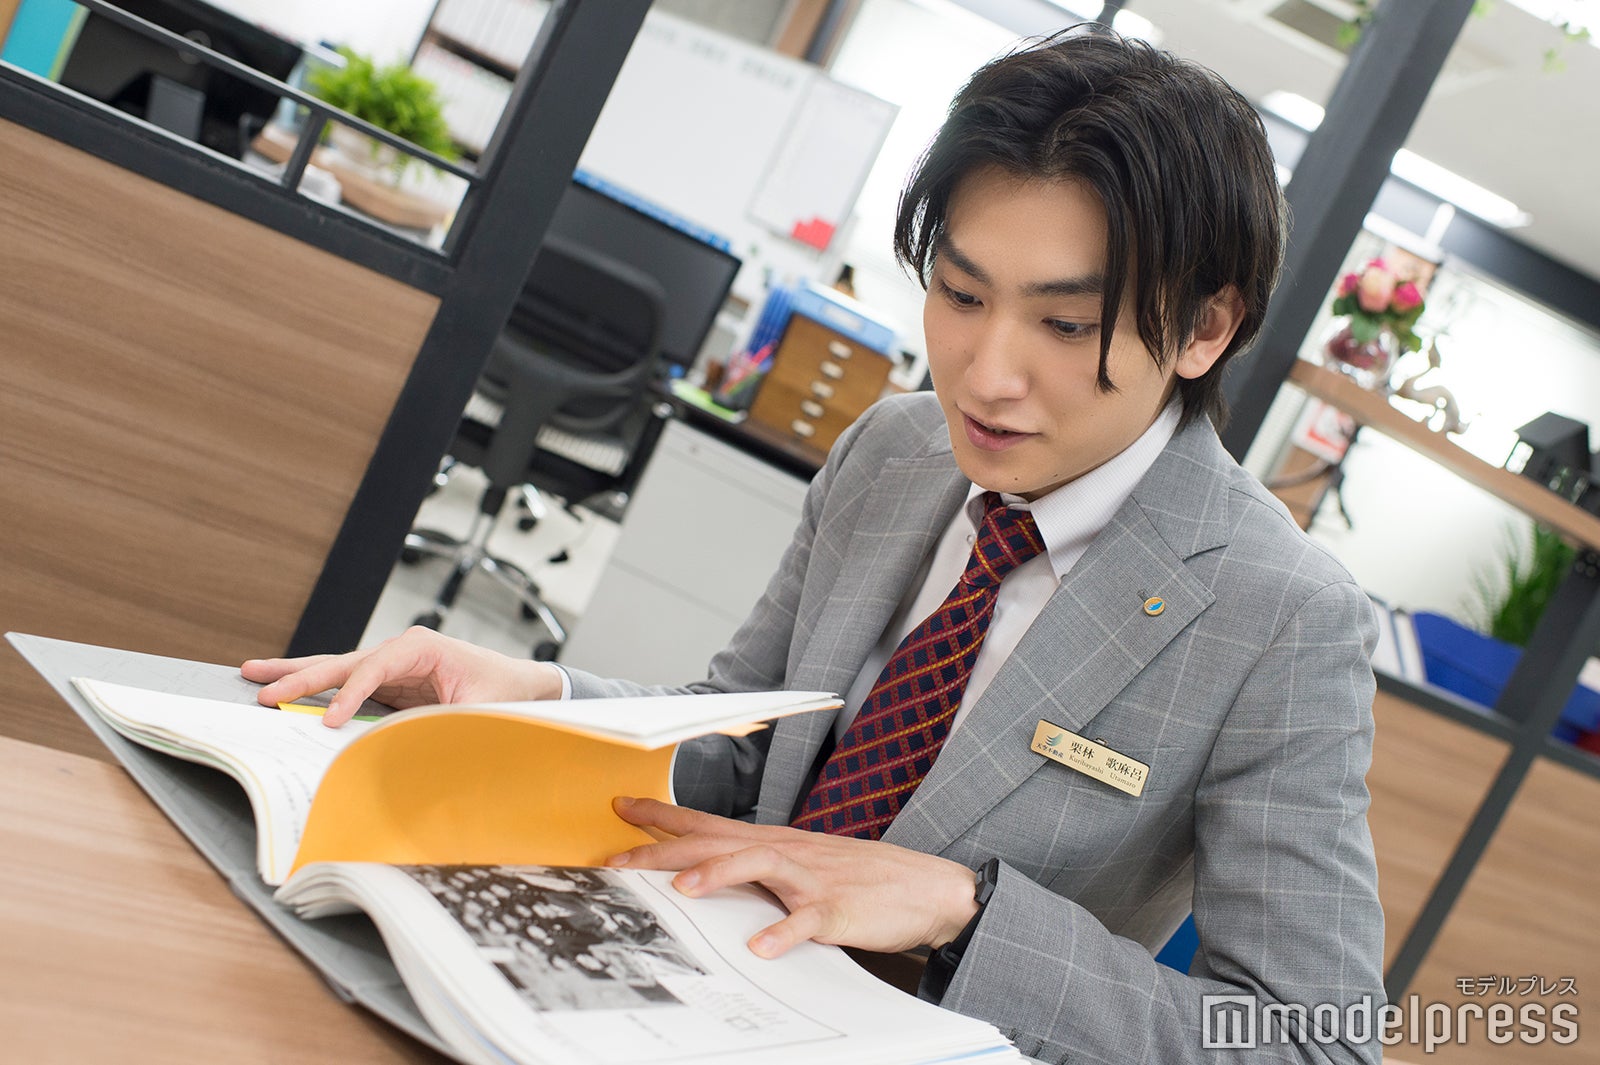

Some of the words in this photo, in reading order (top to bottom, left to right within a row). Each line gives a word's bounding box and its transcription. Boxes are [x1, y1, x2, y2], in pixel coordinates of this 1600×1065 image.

[1069, 754, 1104, 774] Kuribayashi
[1109, 772, 1136, 788] Utamaro
[1072, 741, 1096, 759] 栗林
[1105, 757, 1142, 781] 歌麻呂
